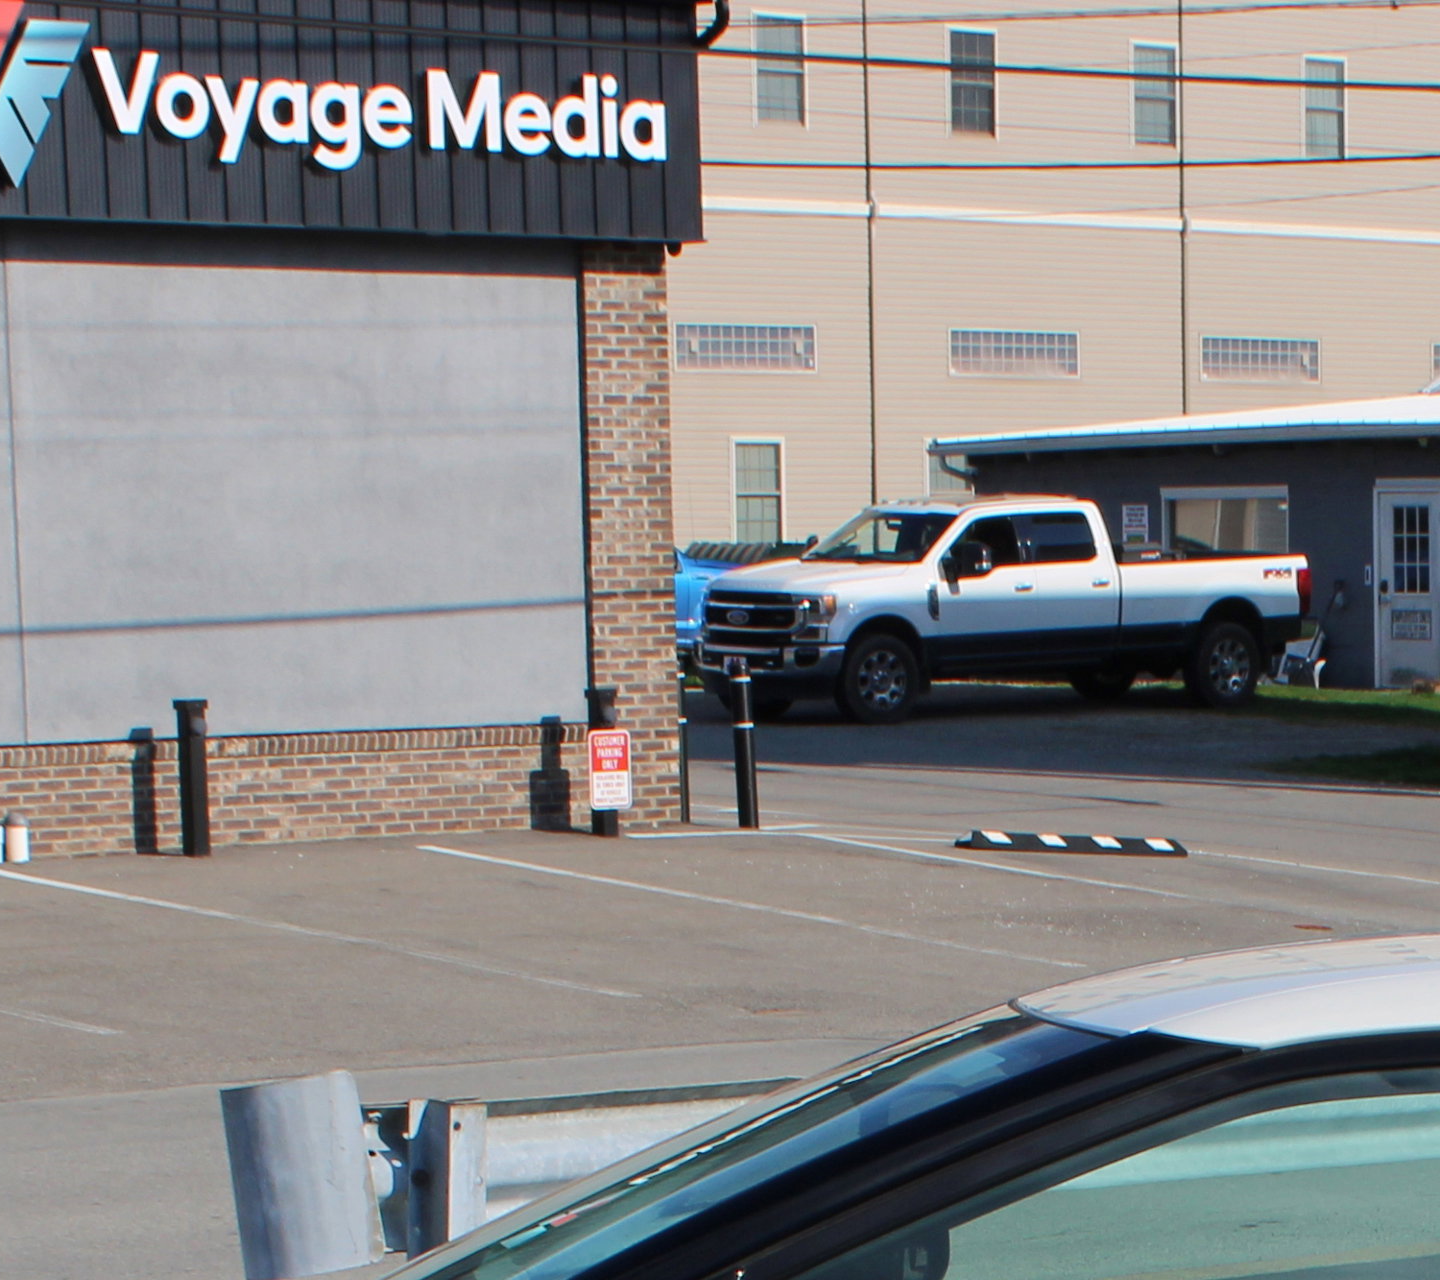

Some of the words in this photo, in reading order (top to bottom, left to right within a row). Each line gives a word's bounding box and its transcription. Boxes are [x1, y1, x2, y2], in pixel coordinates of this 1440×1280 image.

[92, 48, 413, 171] Voyage
[426, 67, 668, 163] Media
[593, 735, 626, 747] CUSTOMER
[596, 747, 624, 759] PARKING
[601, 759, 619, 770] ONLY
